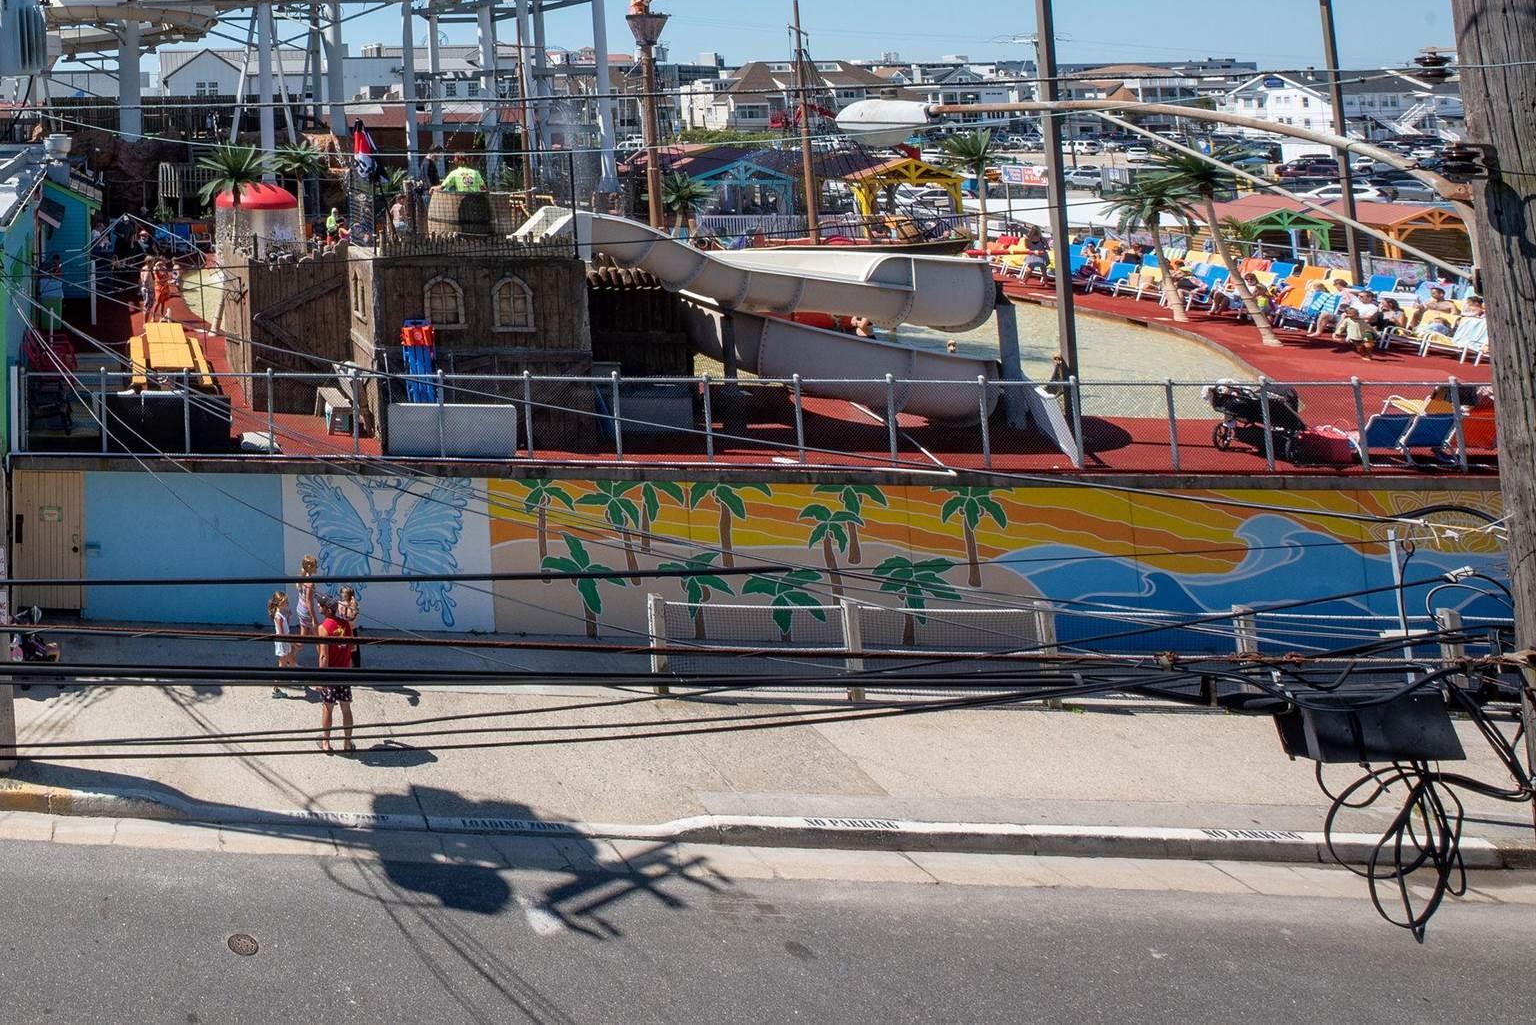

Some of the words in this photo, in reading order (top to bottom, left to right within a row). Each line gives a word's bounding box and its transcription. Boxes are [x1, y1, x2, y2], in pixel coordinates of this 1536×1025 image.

[461, 818, 525, 829] LOADING
[527, 820, 564, 831] ZONE
[804, 818, 826, 826] NO
[828, 819, 899, 829] PARKING
[1202, 830, 1228, 839] NO
[1228, 830, 1304, 840] PARKING
